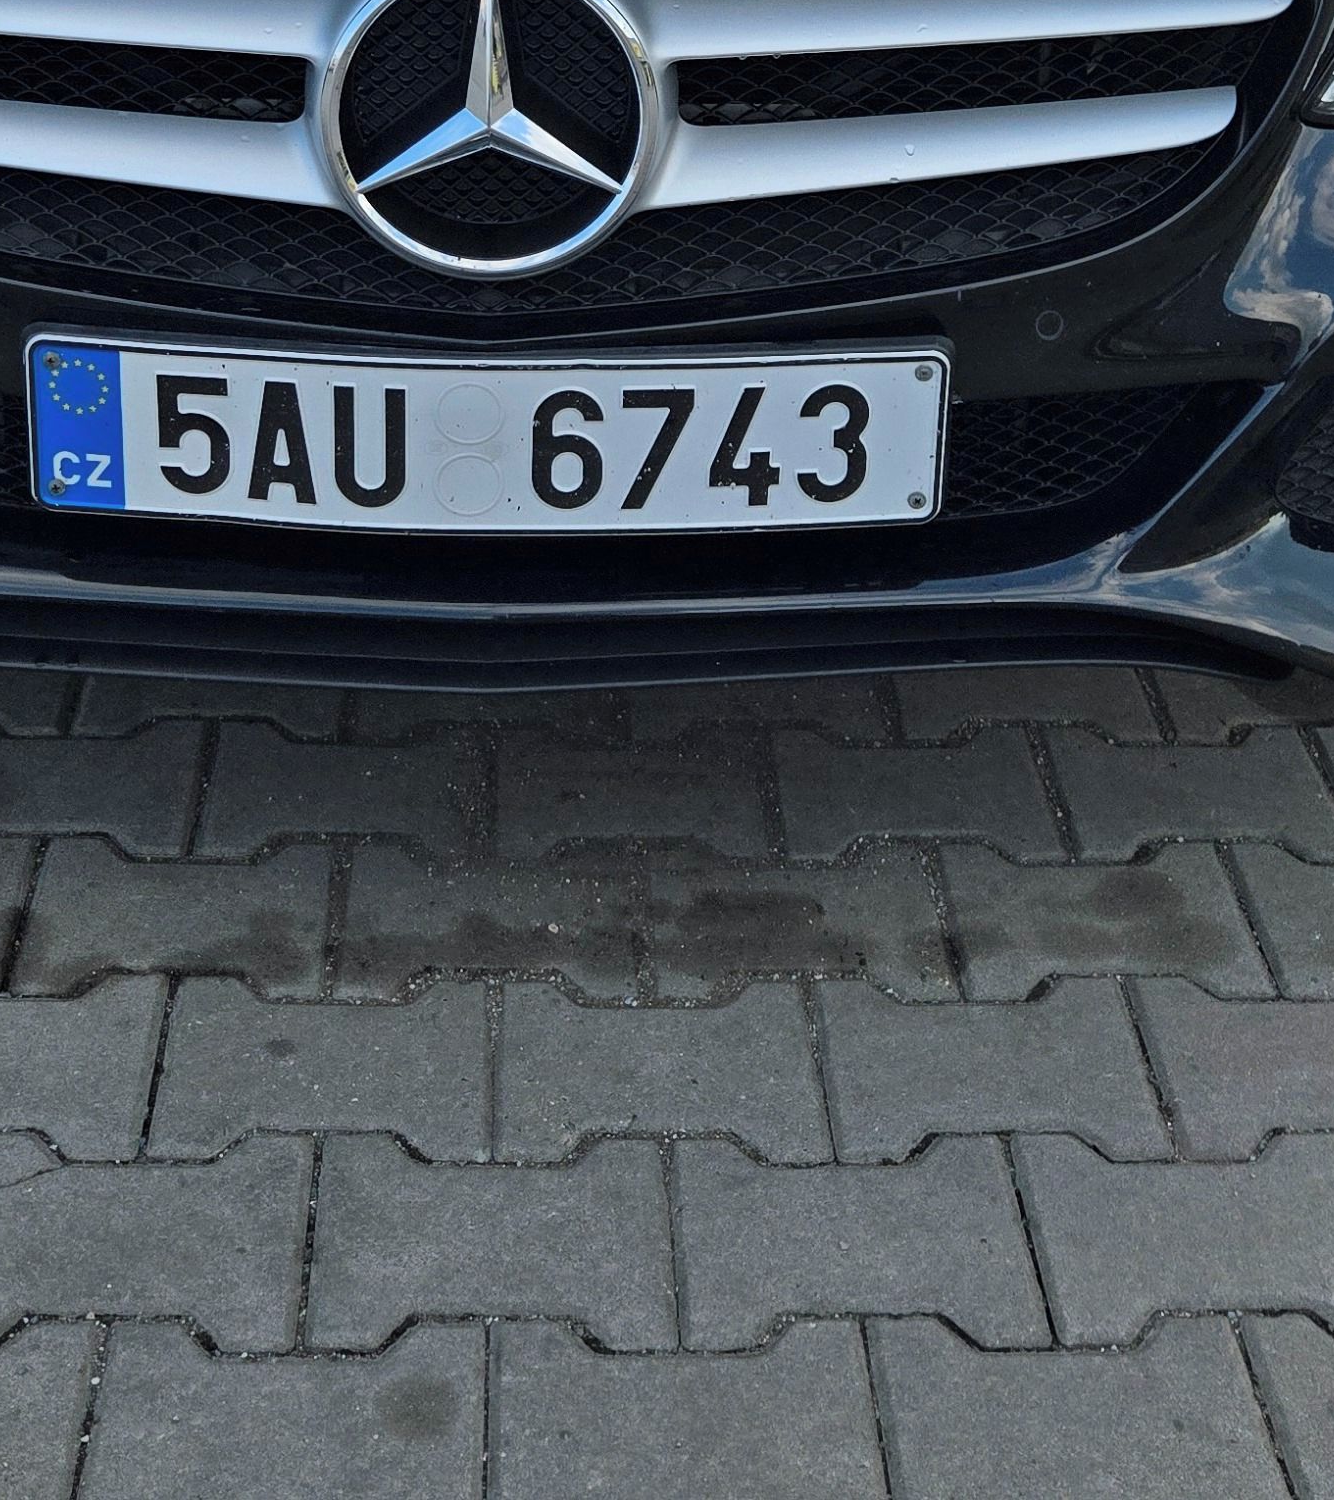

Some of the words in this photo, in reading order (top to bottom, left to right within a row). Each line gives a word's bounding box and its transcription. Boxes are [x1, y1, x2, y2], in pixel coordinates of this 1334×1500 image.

[53, 450, 112, 488] CZ
[156, 373, 407, 509] 5AU
[531, 383, 870, 511] 6743
